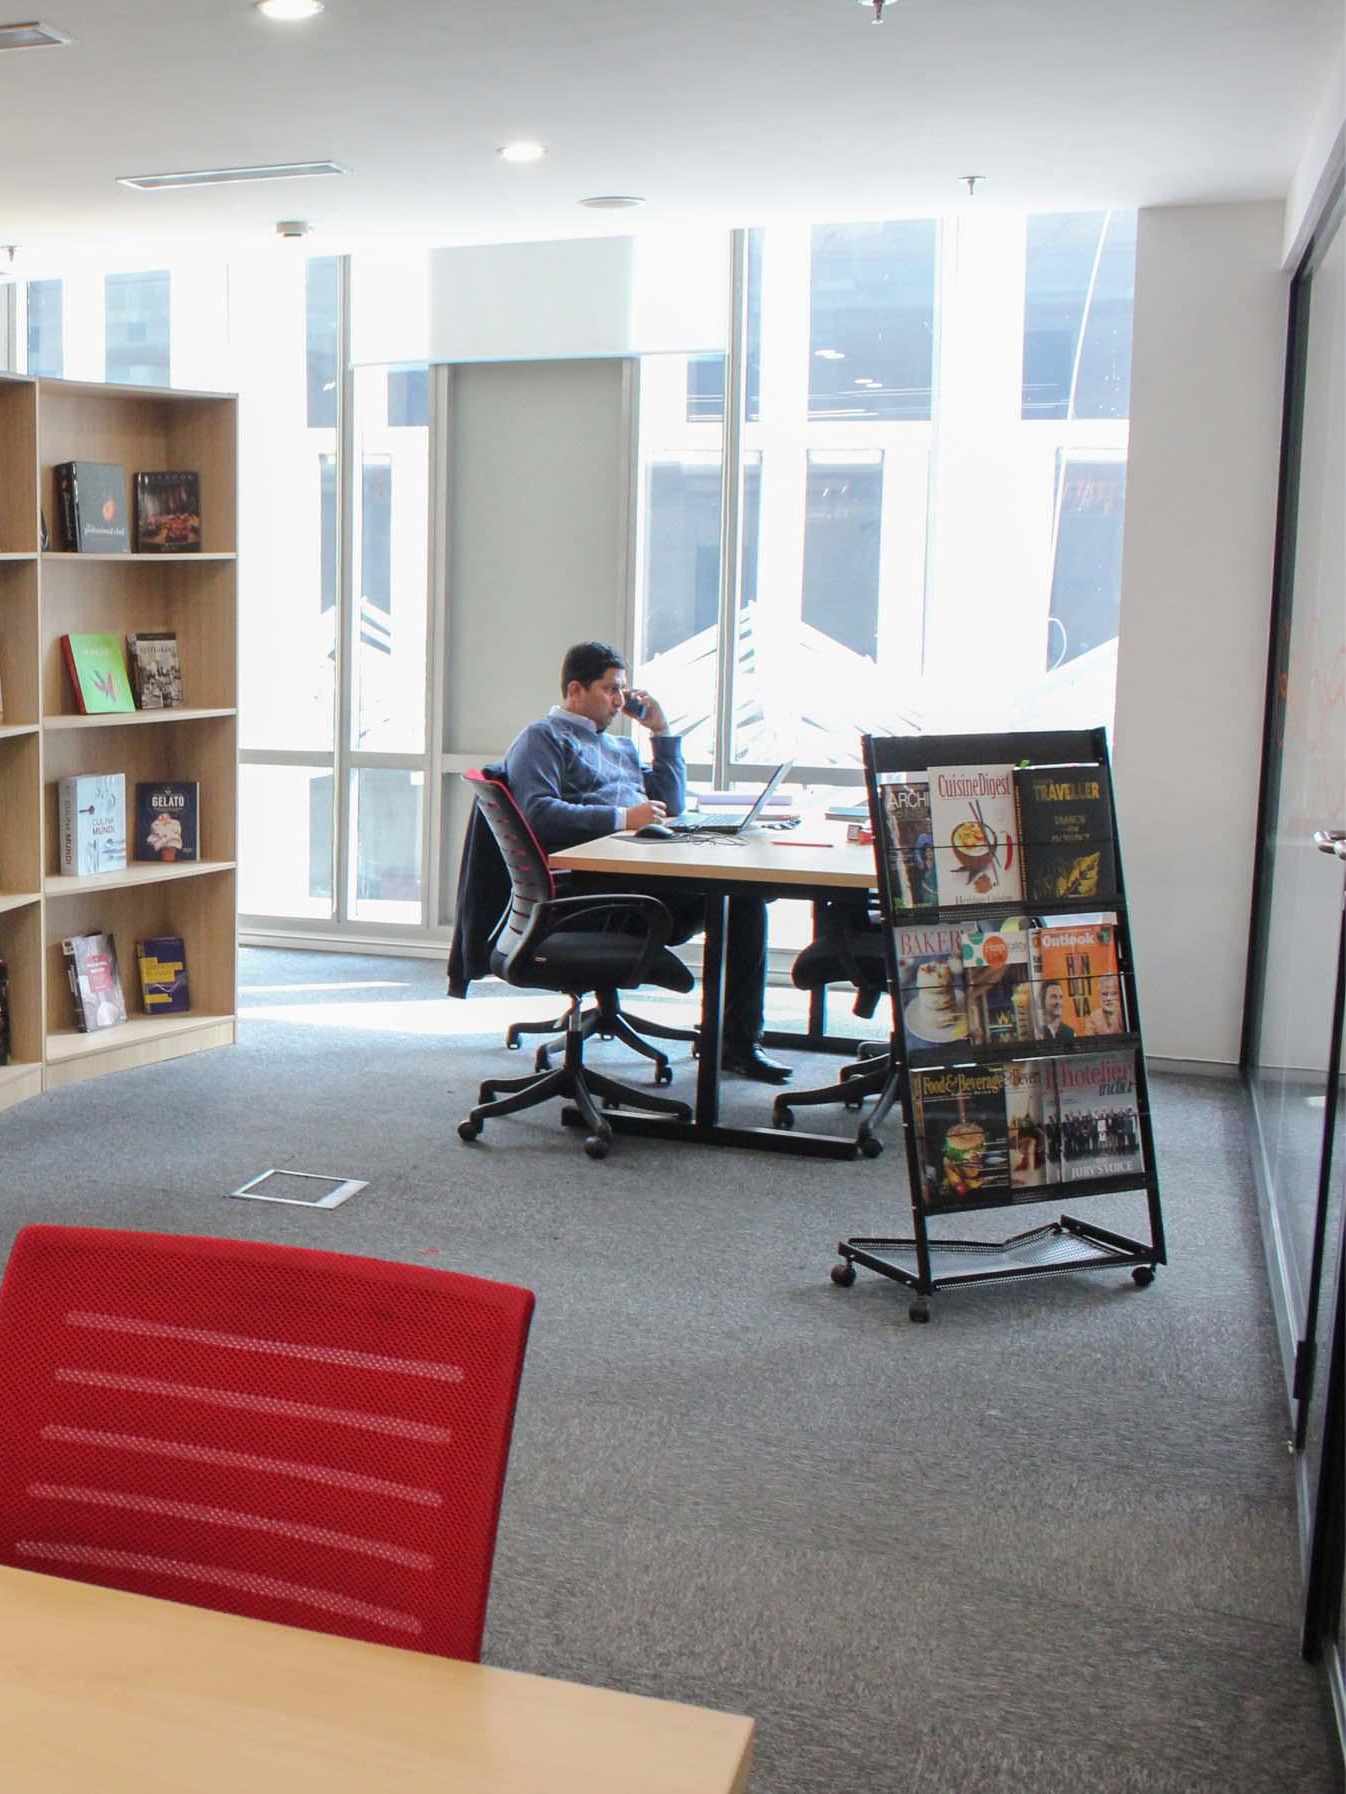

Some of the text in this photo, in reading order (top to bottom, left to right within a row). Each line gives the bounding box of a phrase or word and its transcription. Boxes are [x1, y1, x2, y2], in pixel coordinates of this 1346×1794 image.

[1032, 781, 1100, 801] TRAVELLER
[151, 796, 184, 807] GELATO
[92, 825, 115, 836] MUNDI
[901, 931, 961, 955] BAKER
[1042, 933, 1095, 948] Outlook
[1062, 1060, 1136, 1089] hotelier
[923, 1076, 946, 1096] Food
[958, 1073, 1003, 1093] Beverage
[1103, 1161, 1134, 1175] VOICE
